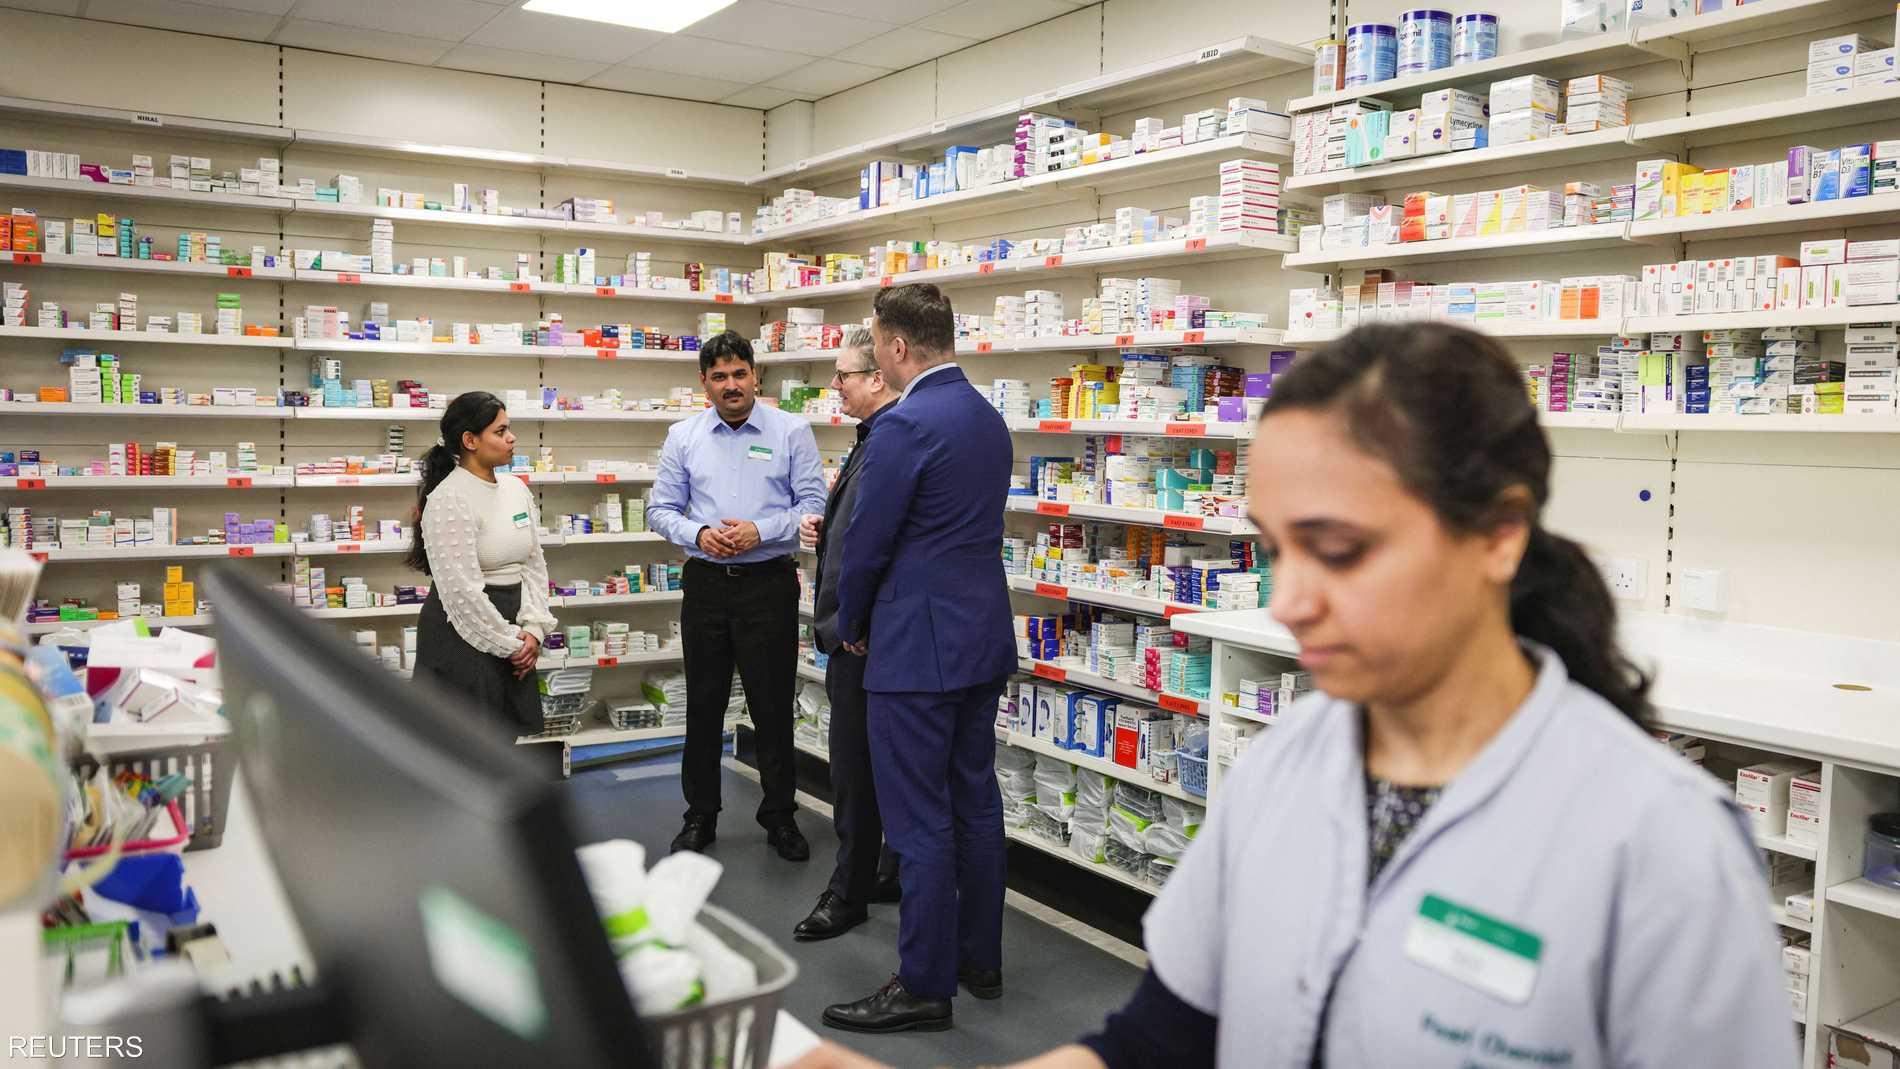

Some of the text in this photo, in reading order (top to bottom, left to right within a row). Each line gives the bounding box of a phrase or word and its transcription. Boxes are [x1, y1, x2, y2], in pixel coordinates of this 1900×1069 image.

[1201, 49, 1219, 60] ABID
[1450, 114, 1482, 129] Lymecycline
[1193, 240, 1199, 249] V
[23, 255, 30, 263] A
